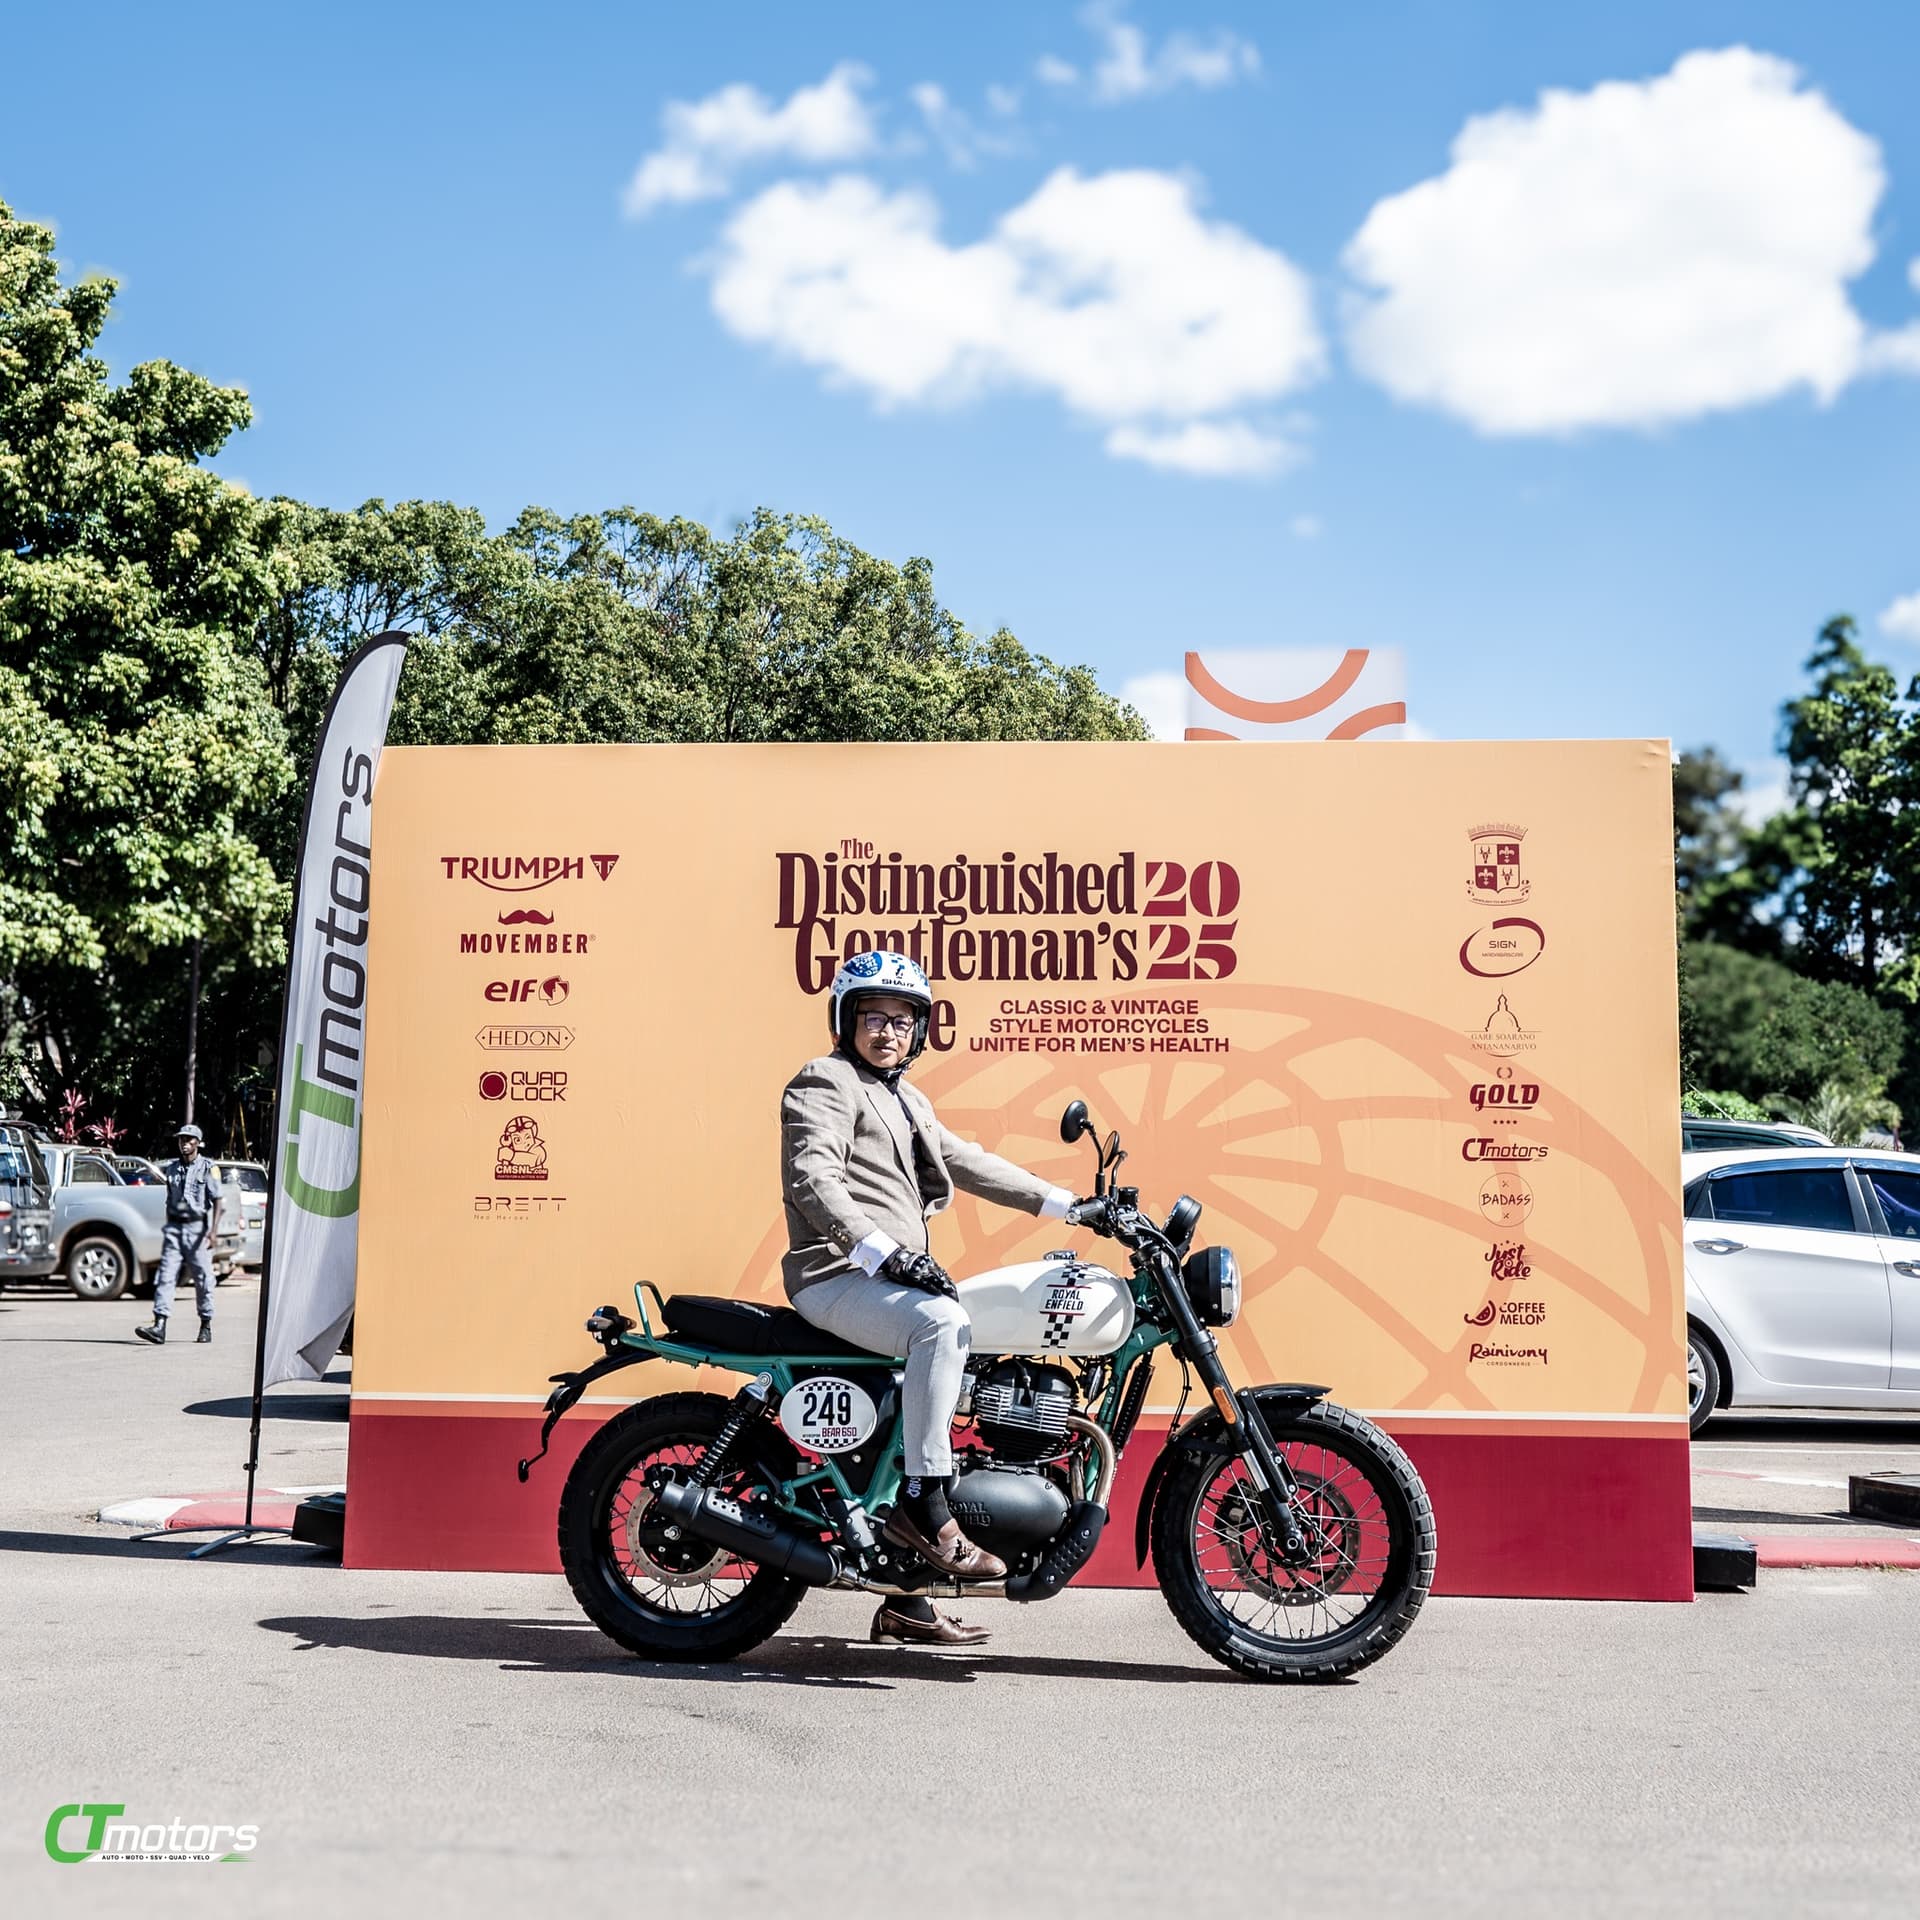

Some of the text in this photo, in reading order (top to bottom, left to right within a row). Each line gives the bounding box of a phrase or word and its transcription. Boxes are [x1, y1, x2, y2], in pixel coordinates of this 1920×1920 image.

[841, 838, 873, 860] The
[440, 856, 584, 892] TRIUMPH
[774, 851, 1241, 928] Distinguished 20
[1145, 918, 1239, 980] 25
[1488, 940, 1517, 949] SIGN
[484, 979, 538, 1002] elf
[999, 1000, 1199, 1015] CLASSIC & VINTAGE
[989, 1018, 1209, 1033] STYLE MOTORCYCLES
[488, 1030, 561, 1046] HEDON
[969, 1037, 1230, 1052] UNITE FOR MEN'S HEALTH
[511, 1071, 568, 1086] QUAD
[511, 1087, 567, 1101] LOCK
[1469, 1084, 1540, 1110] GOLD
[1462, 1138, 1549, 1161] CTmotors
[474, 1196, 567, 1211] BRETT
[1481, 1193, 1532, 1206] BADASS
[1484, 1243, 1526, 1261] Just
[1491, 1258, 1531, 1281] Ride
[1051, 1289, 1081, 1300] ROYAL
[1045, 1300, 1083, 1311] ENFIELD
[1499, 1302, 1546, 1314] COFFEE
[1499, 1314, 1546, 1326] MELON
[1469, 1342, 1548, 1365] Rainivony
[803, 1392, 852, 1427] 249
[822, 1427, 840, 1438] BEAR
[842, 1427, 857, 1438] 650
